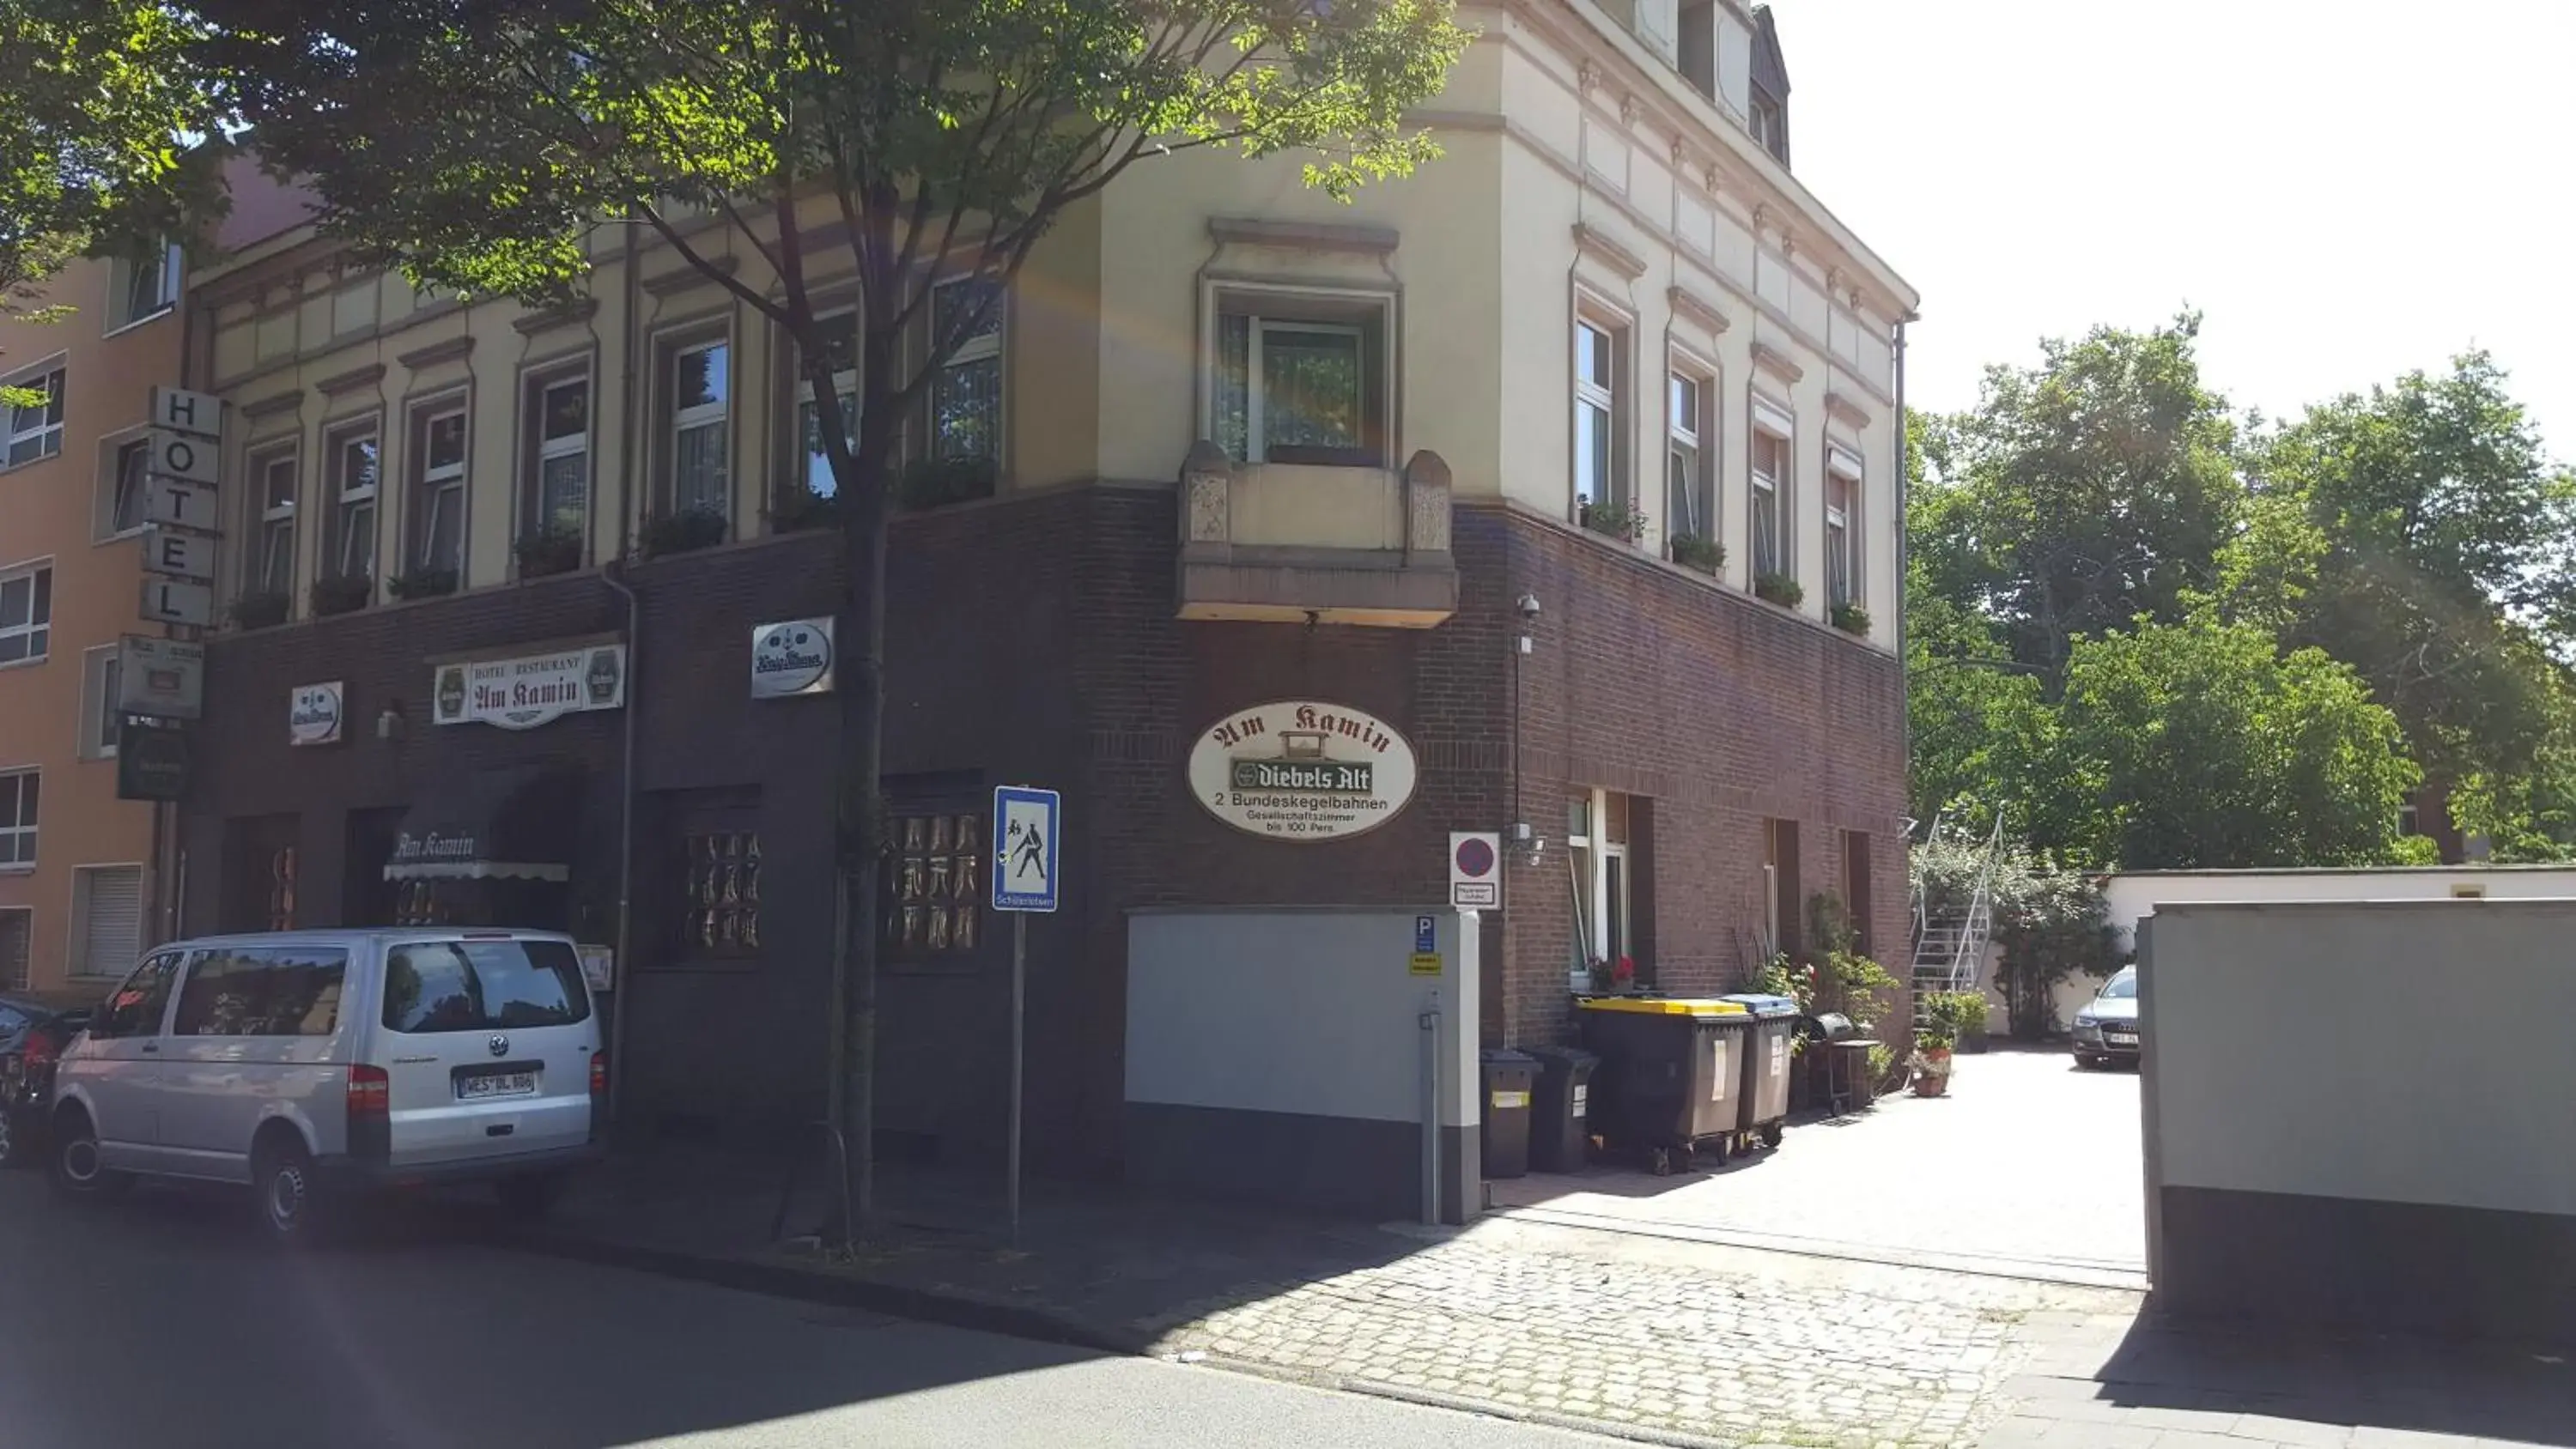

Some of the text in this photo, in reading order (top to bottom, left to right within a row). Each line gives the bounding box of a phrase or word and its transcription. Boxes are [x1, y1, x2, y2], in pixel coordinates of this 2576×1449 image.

[160, 393, 195, 616] HOTEL
[516, 658, 580, 675] RESTAURANT
[474, 676, 577, 710] Am Kamin
[1213, 705, 1390, 753] Am Kamin
[1258, 764, 1370, 790] Diebels Alt
[1215, 792, 1388, 811] 2 Bundeskegelbahnen
[1267, 822, 1282, 833] bis
[1287, 823, 1306, 833] 100
[422, 831, 474, 857] Kamin
[1419, 919, 1431, 935] P
